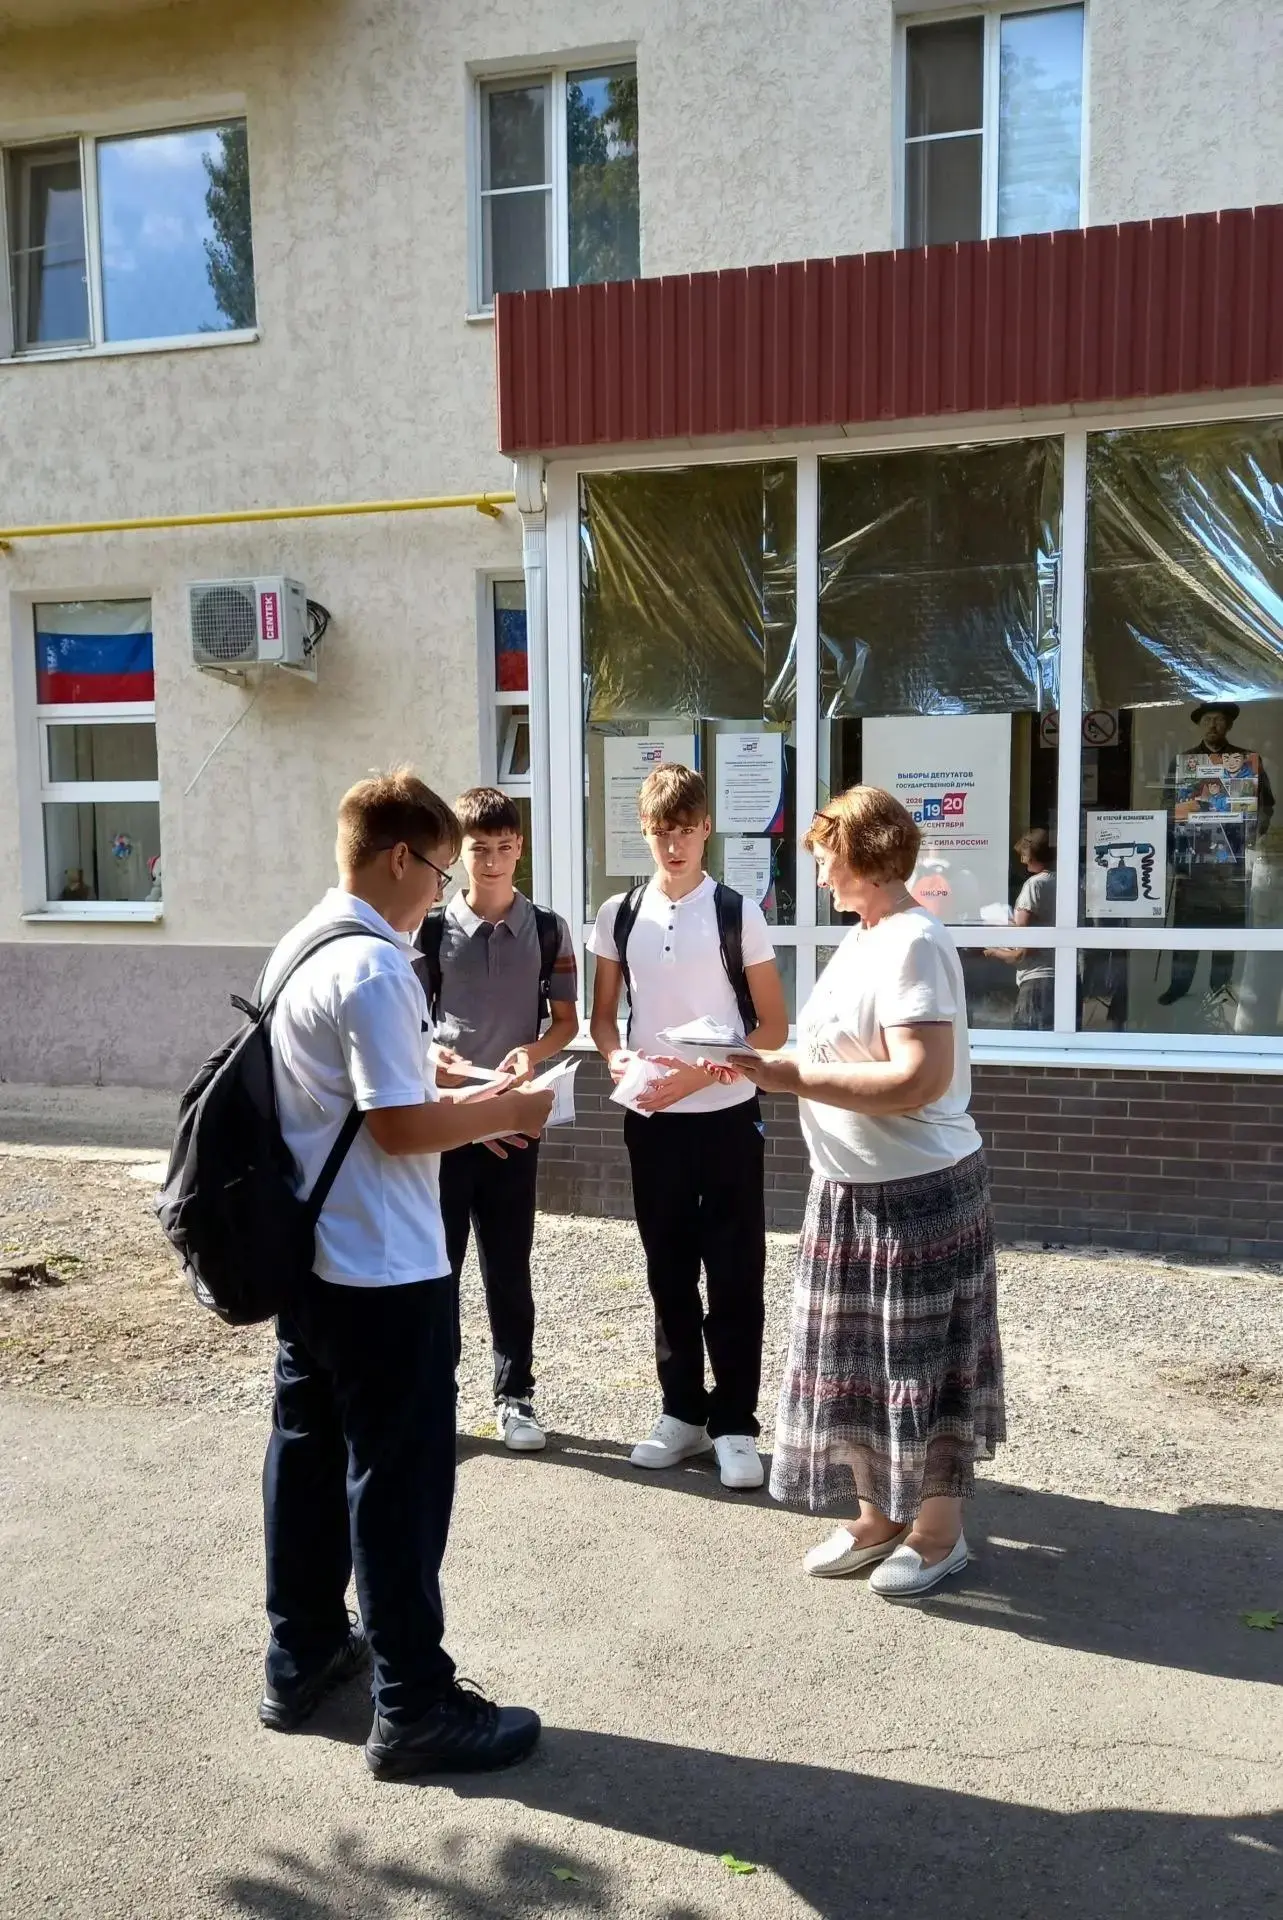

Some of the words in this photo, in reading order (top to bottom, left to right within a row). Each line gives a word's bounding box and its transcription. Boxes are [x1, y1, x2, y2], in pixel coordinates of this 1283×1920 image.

[265, 596, 274, 639] CENTEK
[925, 804, 940, 816] 19
[943, 798, 962, 810] 20
